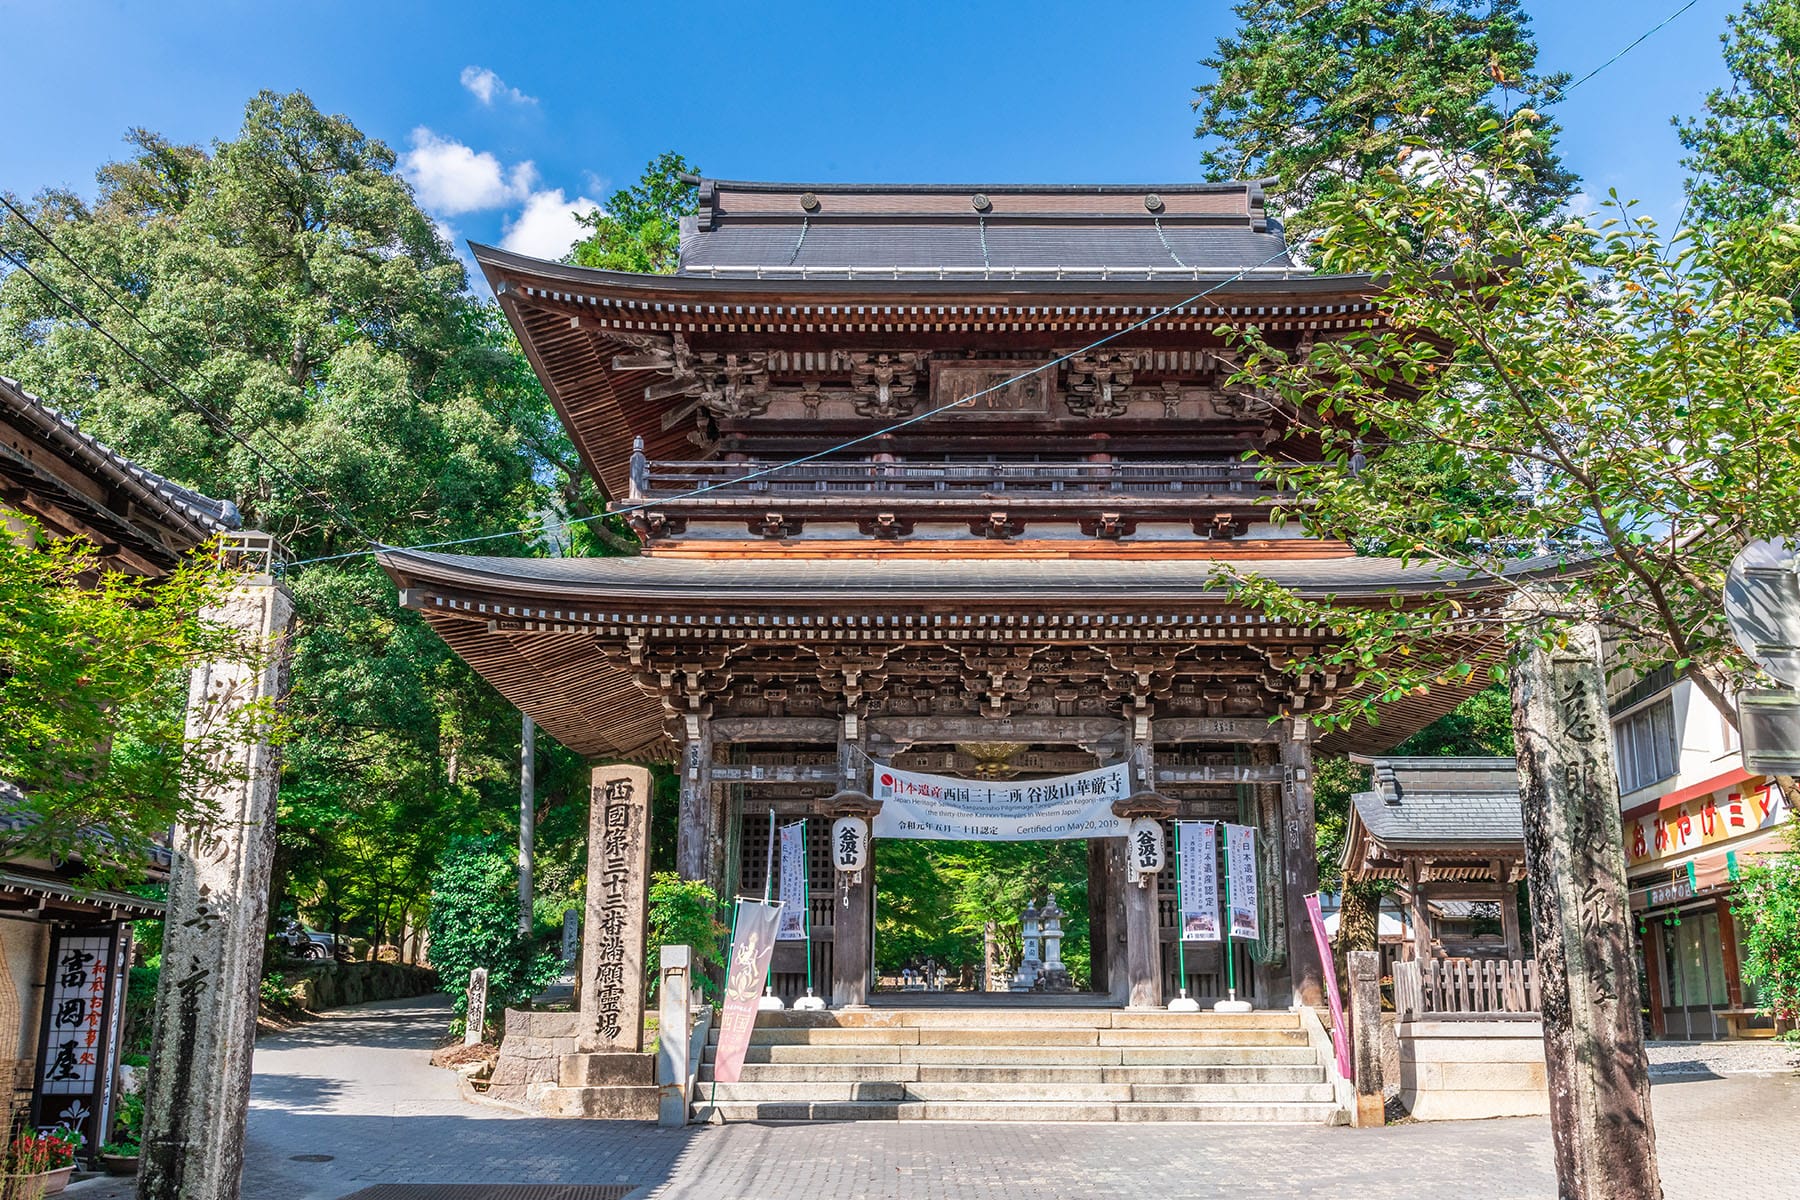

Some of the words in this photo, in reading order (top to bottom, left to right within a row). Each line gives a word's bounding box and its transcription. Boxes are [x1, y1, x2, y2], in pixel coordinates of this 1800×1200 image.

[1027, 772, 1122, 803] 谷汲山華厳寺
[840, 826, 859, 866] 谷汲山
[1016, 825, 1052, 835] Certified
[1098, 820, 1119, 829] 2019
[1136, 830, 1158, 868] 谷汲山
[46, 949, 94, 1082] 富岡屋
[79, 959, 107, 1065] 和風お食事処
